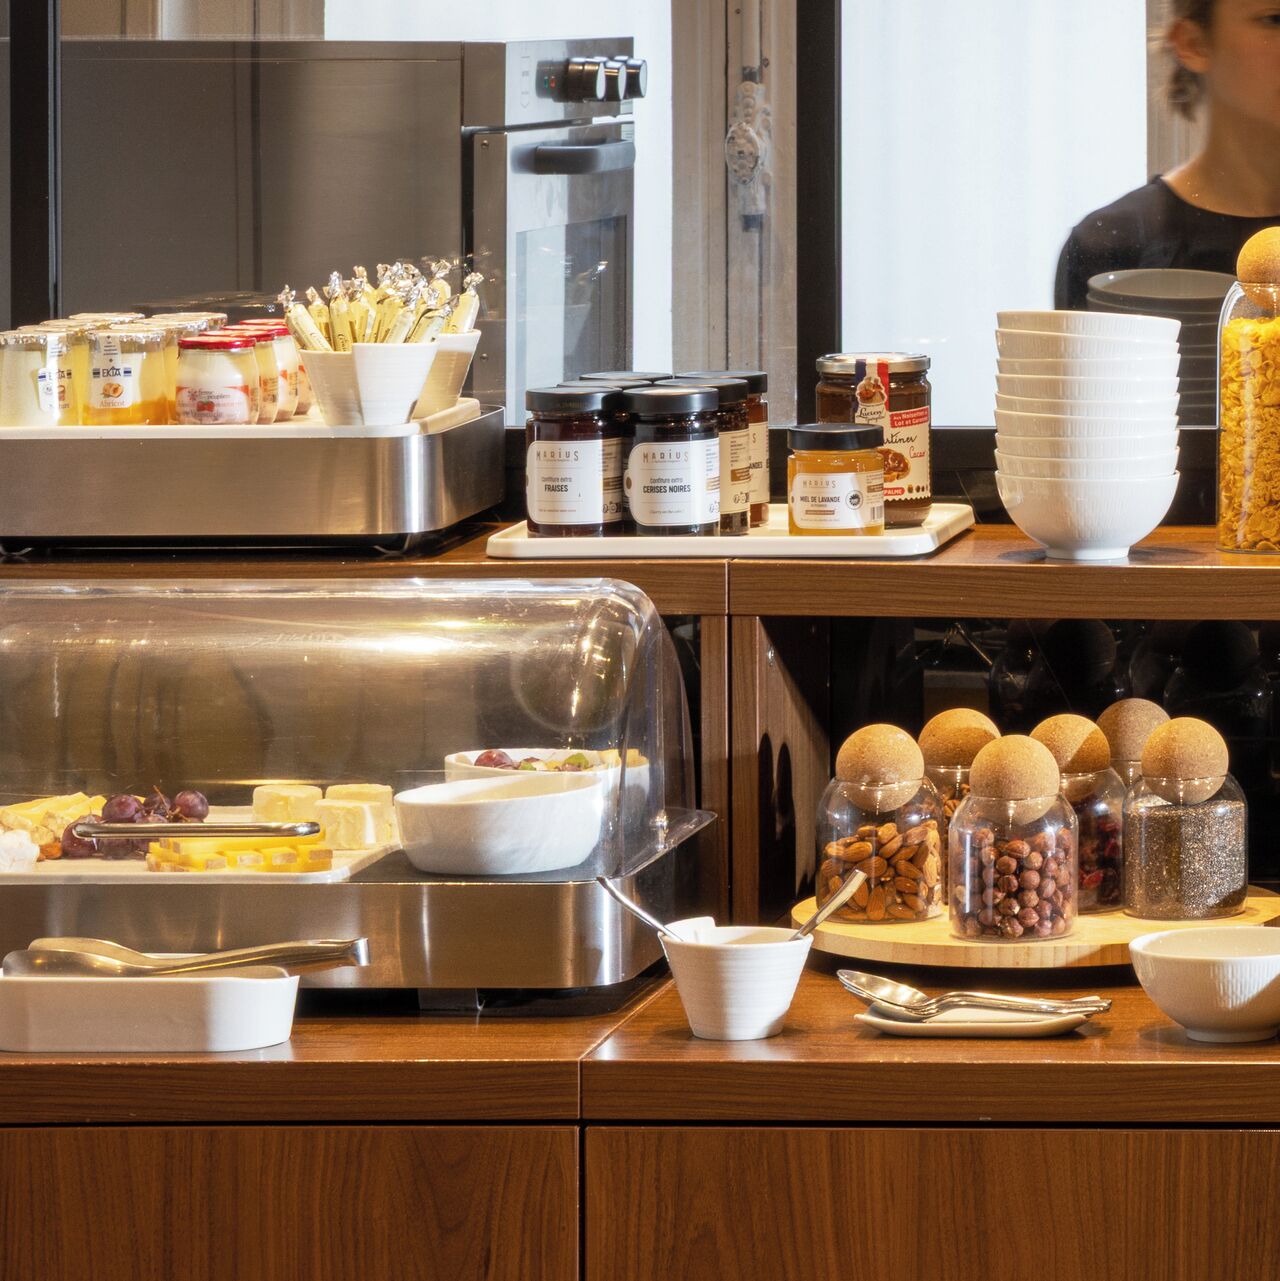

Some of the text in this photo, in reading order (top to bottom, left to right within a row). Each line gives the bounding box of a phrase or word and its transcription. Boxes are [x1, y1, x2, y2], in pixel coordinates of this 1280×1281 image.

[536, 448, 579, 461] MARIUS
[643, 449, 689, 463] MARIUS
[544, 484, 569, 493] FRAISES
[643, 484, 691, 494] CERISES NOIRES
[820, 495, 840, 503] LAVANDE
